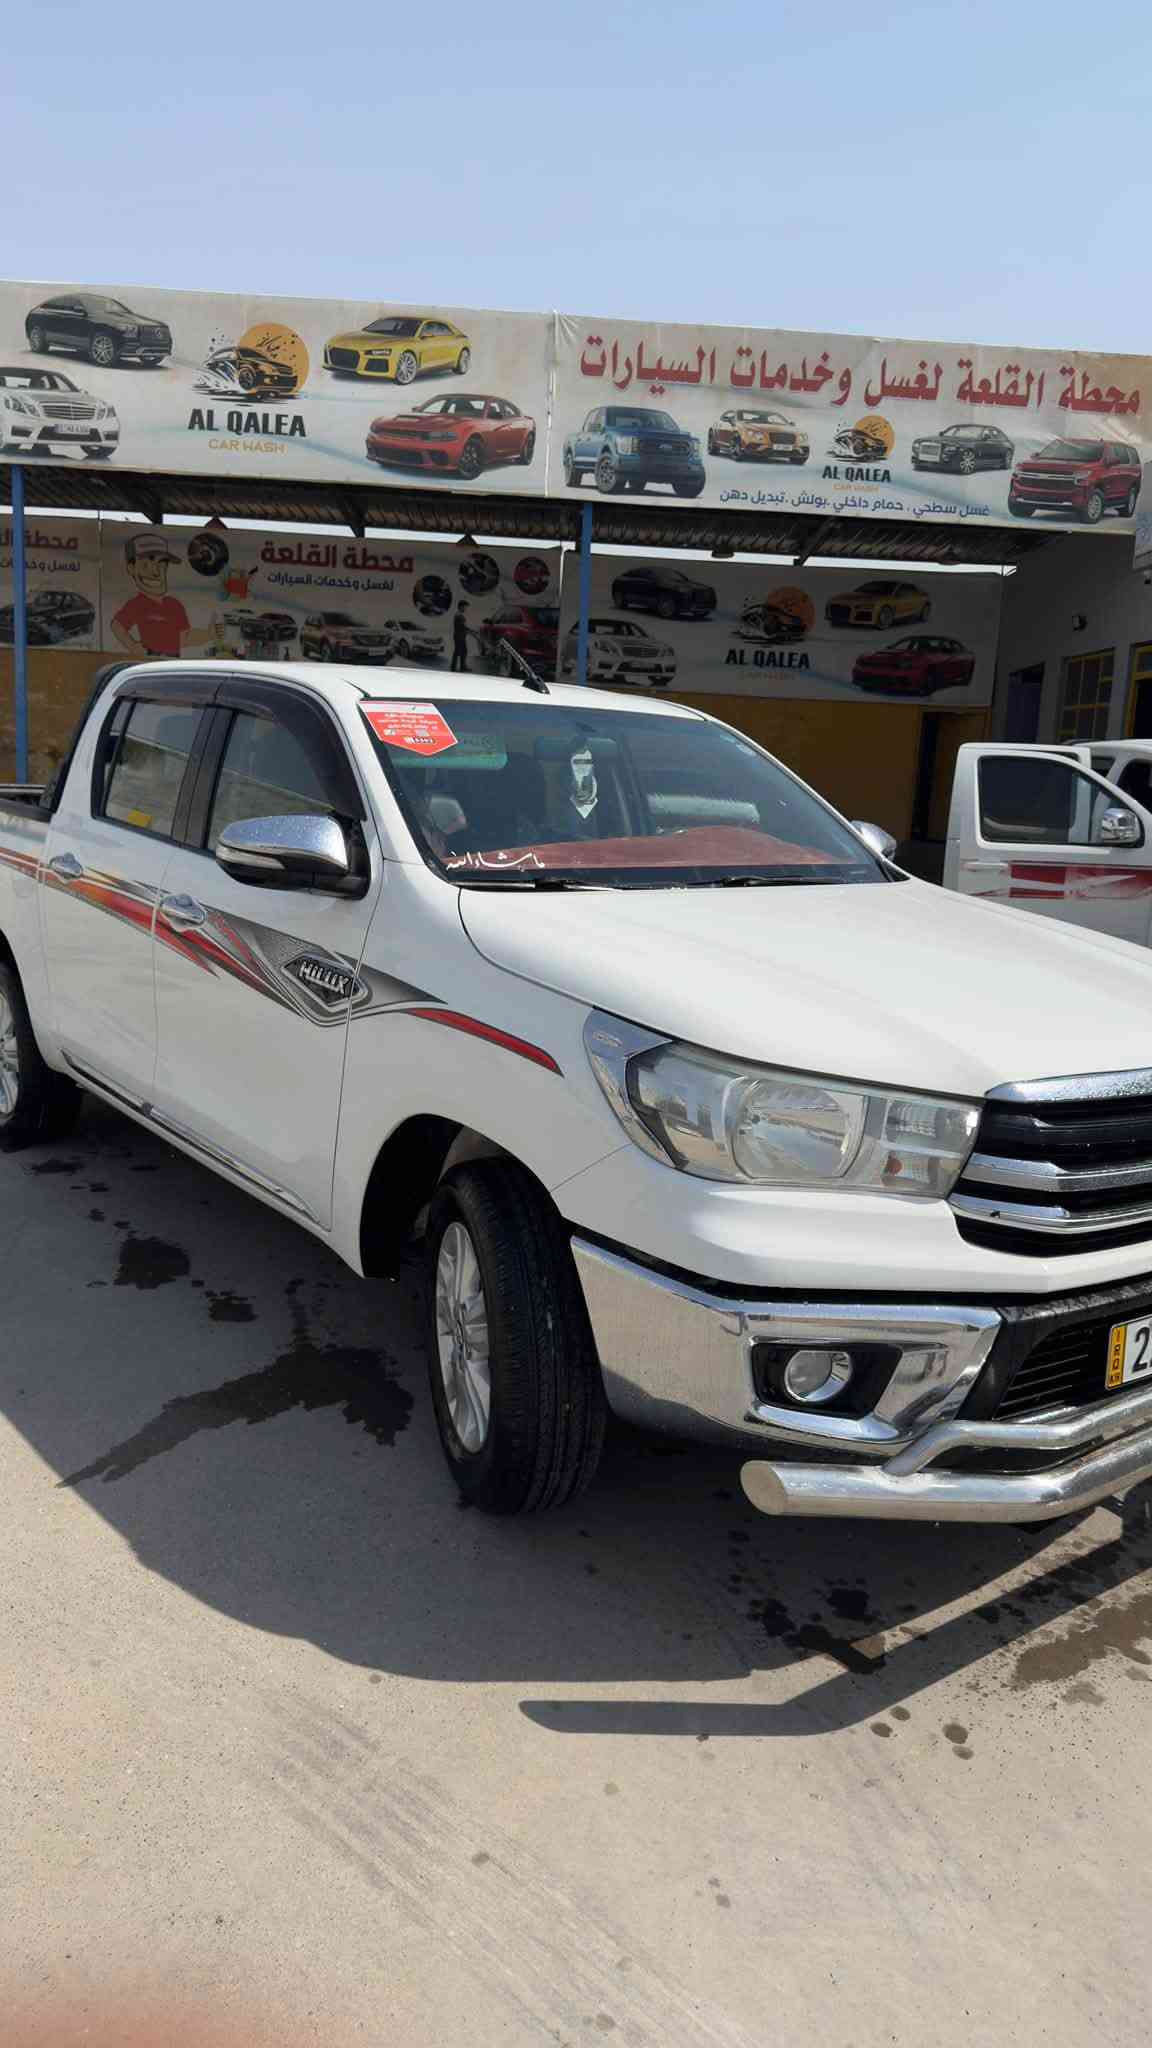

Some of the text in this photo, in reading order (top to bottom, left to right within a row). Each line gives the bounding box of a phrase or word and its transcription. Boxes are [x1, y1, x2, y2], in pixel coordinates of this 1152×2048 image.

[579, 335, 1141, 415] محطة القلعة لغسل وخدمات السيارات
[188, 408, 307, 438] AL QALEA
[208, 438, 286, 454] CAR WASH
[822, 465, 892, 484] AL QALEA
[719, 489, 748, 502] دهن
[871, 498, 903, 512] حمام
[959, 502, 992, 517] غسل
[260, 540, 415, 573] محطة القلعة
[725, 648, 810, 669] AL QALEA
[1132, 1326, 1152, 1375] 2
